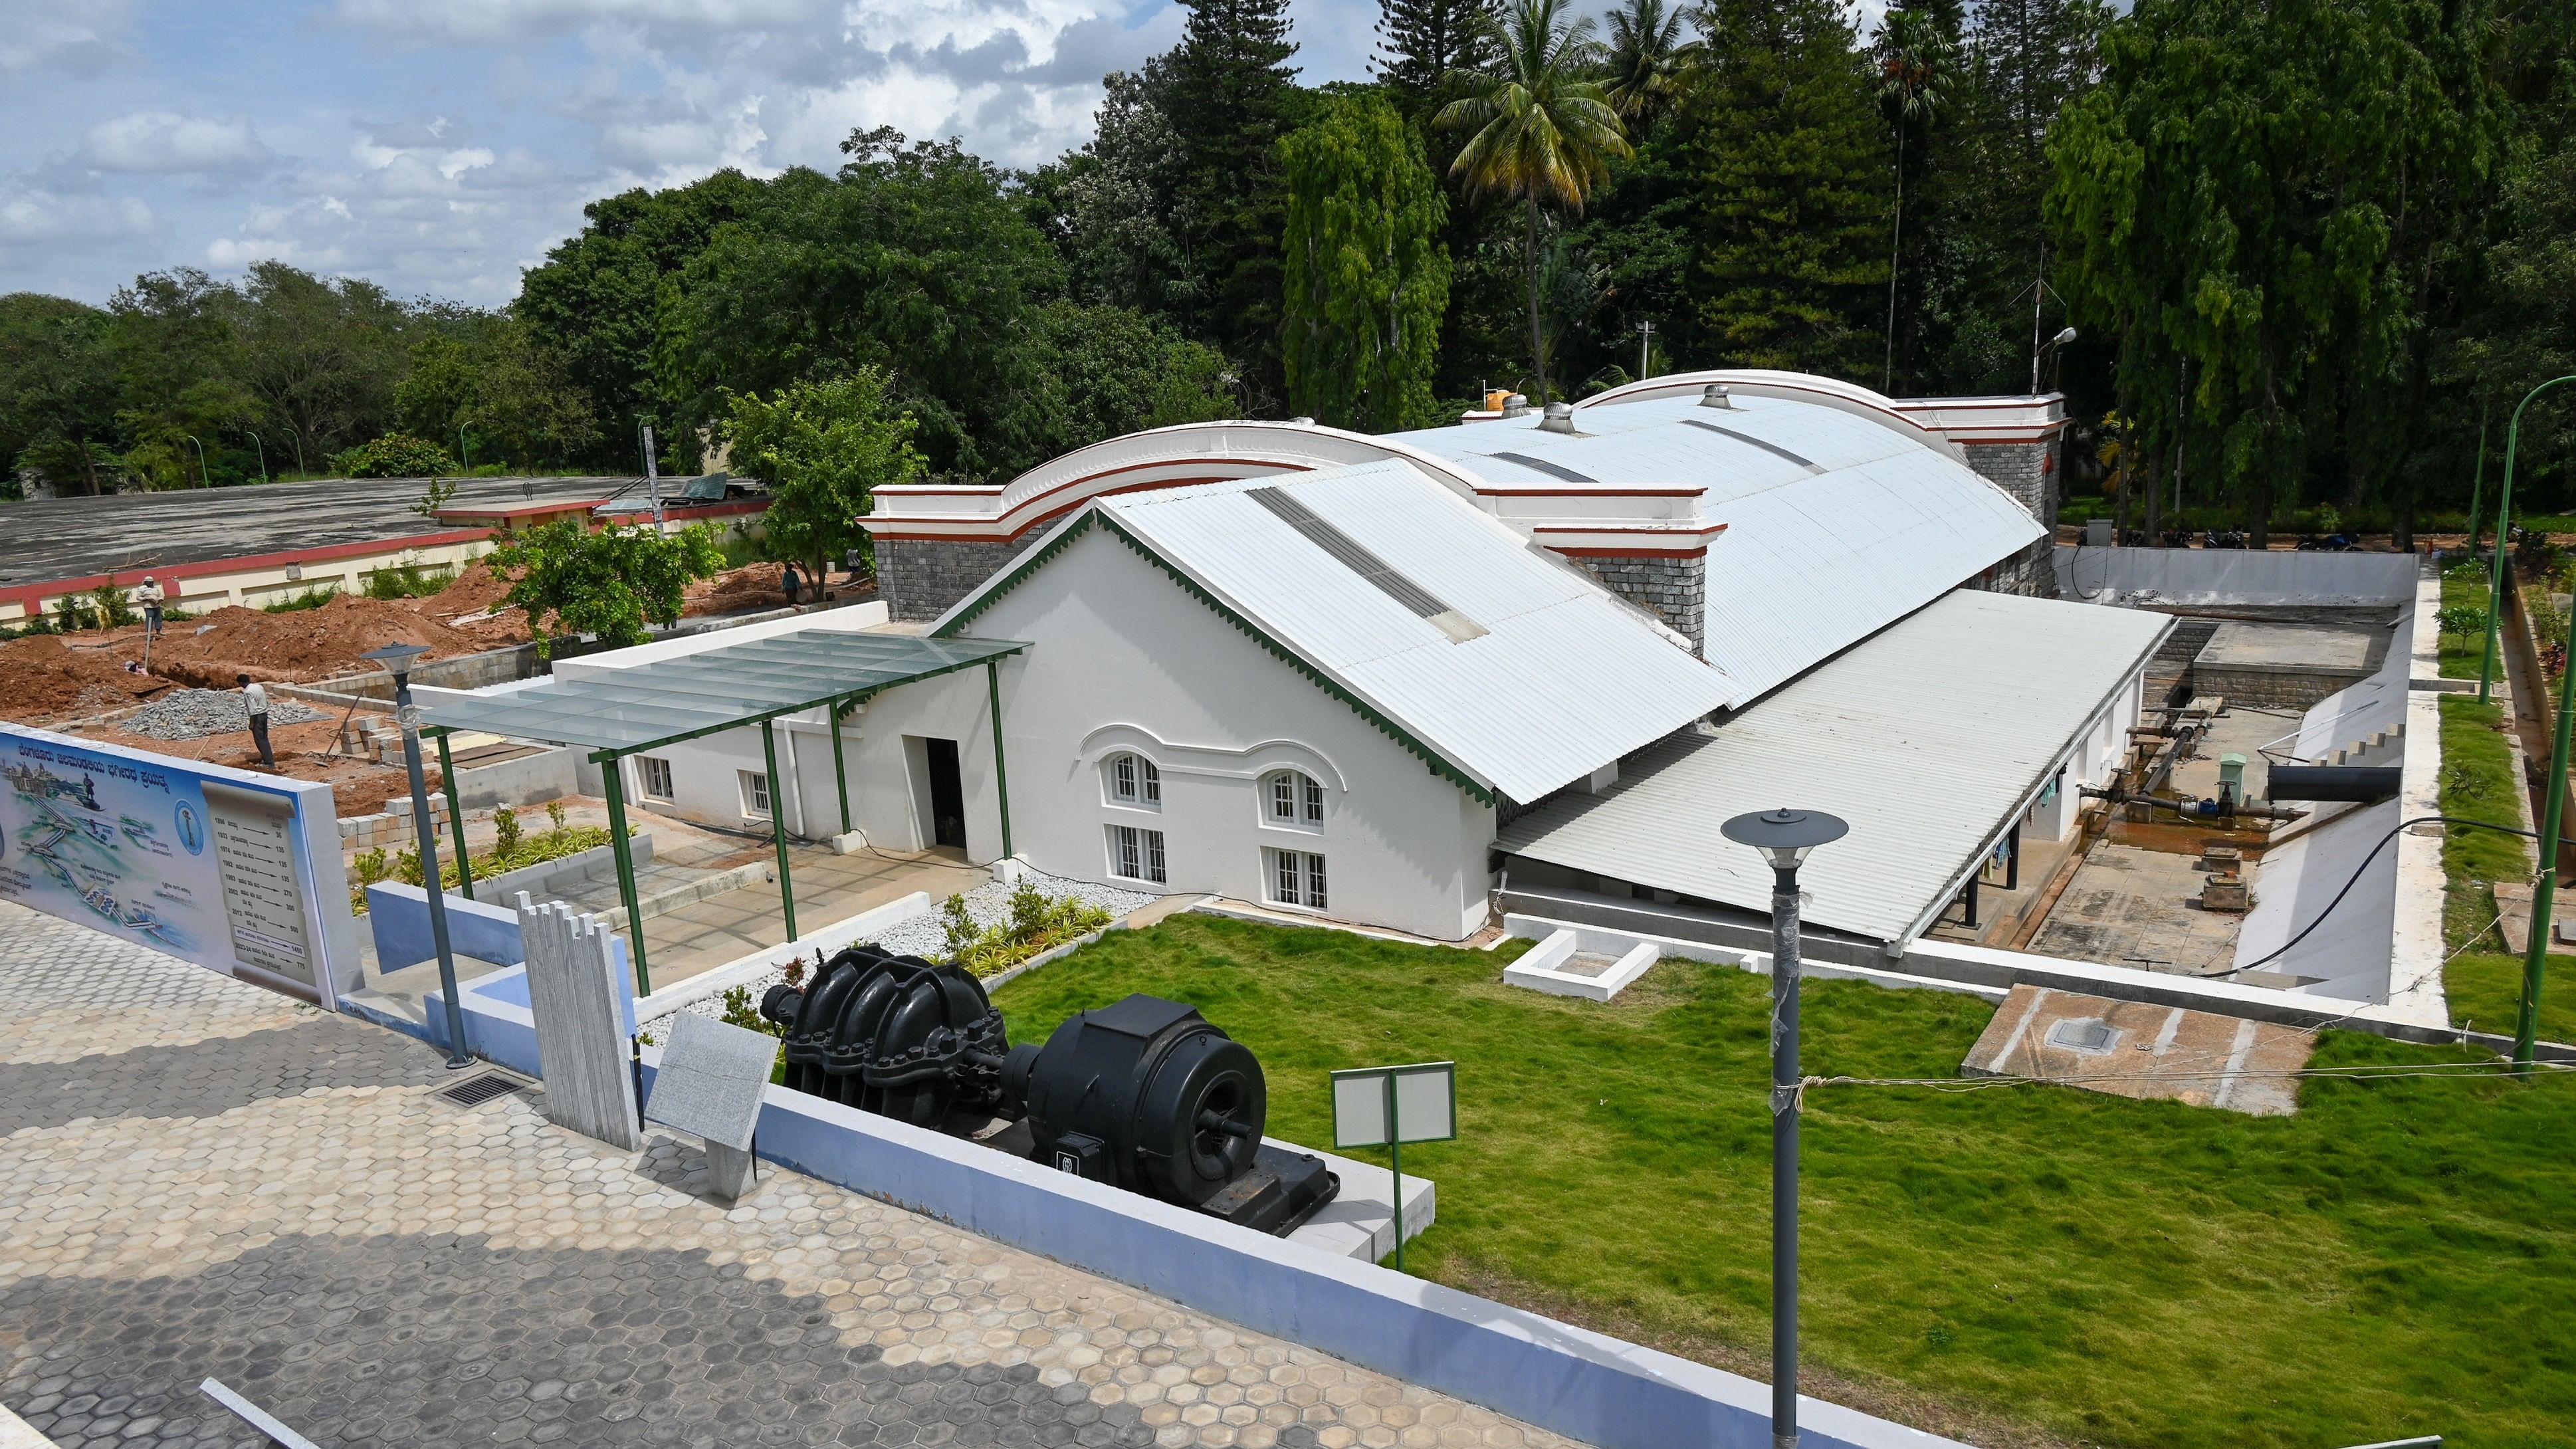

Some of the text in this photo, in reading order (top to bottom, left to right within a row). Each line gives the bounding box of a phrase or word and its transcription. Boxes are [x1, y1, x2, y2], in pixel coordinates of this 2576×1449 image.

[18, 742, 171, 795] ಬೆಂಗಳೂರು ಜಲಮಂಡಳಿಯ ಭಗೀರಥ ಪ್ರಯತ್ನ
[291, 945, 302, 954] 1450
[296, 961, 306, 970] 775
